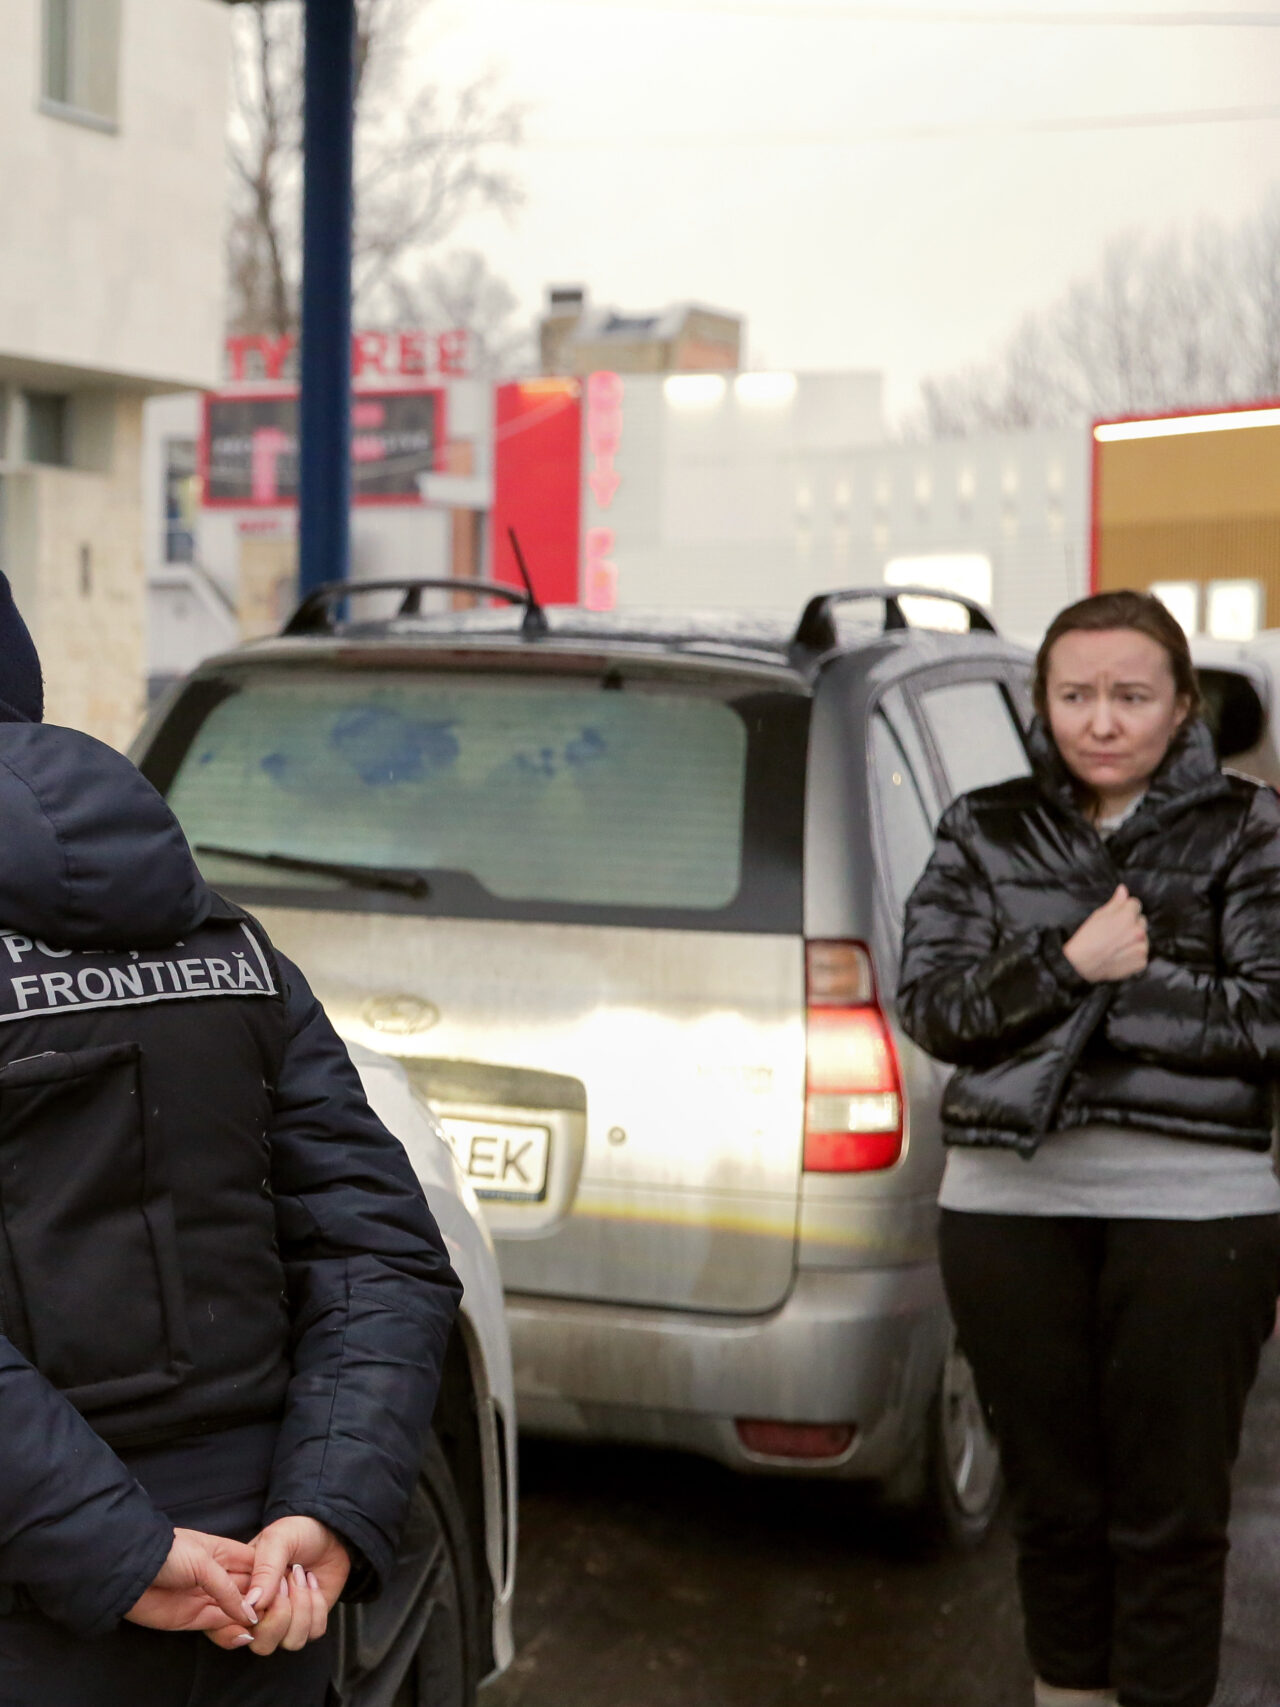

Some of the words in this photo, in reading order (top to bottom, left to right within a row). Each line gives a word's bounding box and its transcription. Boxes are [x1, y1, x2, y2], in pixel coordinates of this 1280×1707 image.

[225, 332, 295, 380] TY
[351, 329, 469, 377] REE
[10, 952, 264, 1010] FRONTIERĂ
